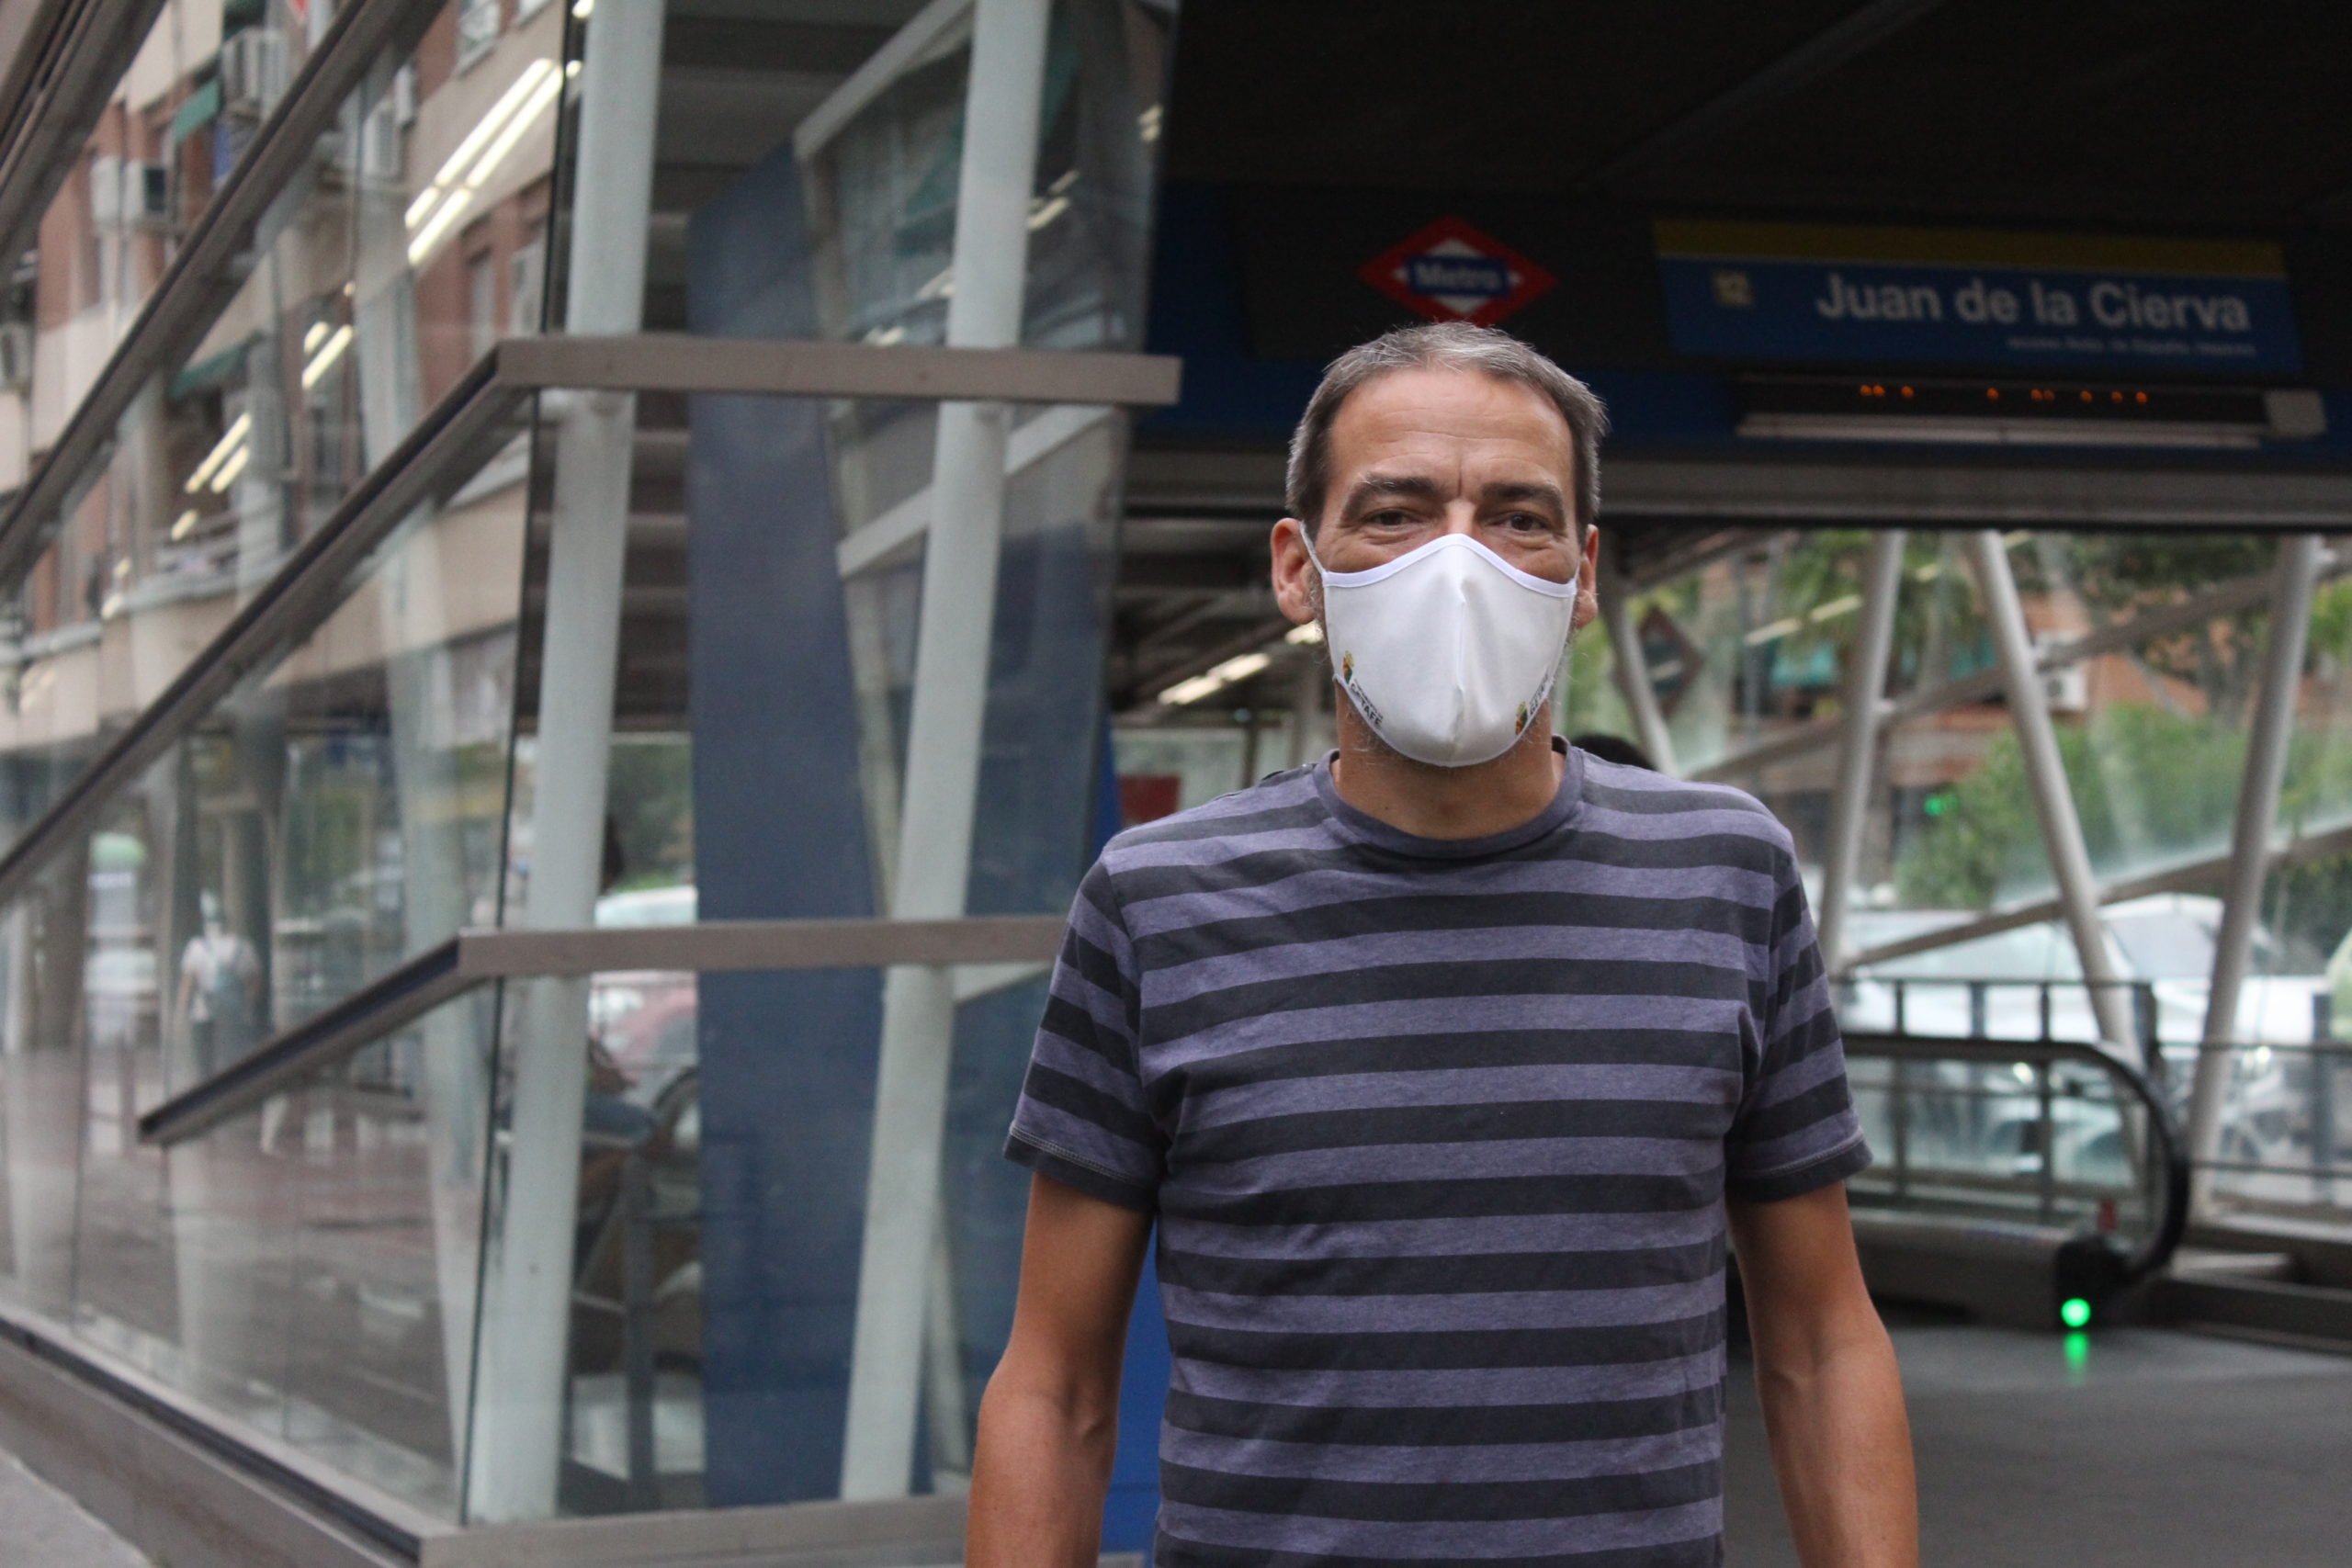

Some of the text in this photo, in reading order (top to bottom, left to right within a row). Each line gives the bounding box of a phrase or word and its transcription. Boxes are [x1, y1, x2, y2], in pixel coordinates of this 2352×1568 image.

[1415, 262, 1501, 292] Metro
[1815, 272, 2250, 333] Juan de la Cierva
